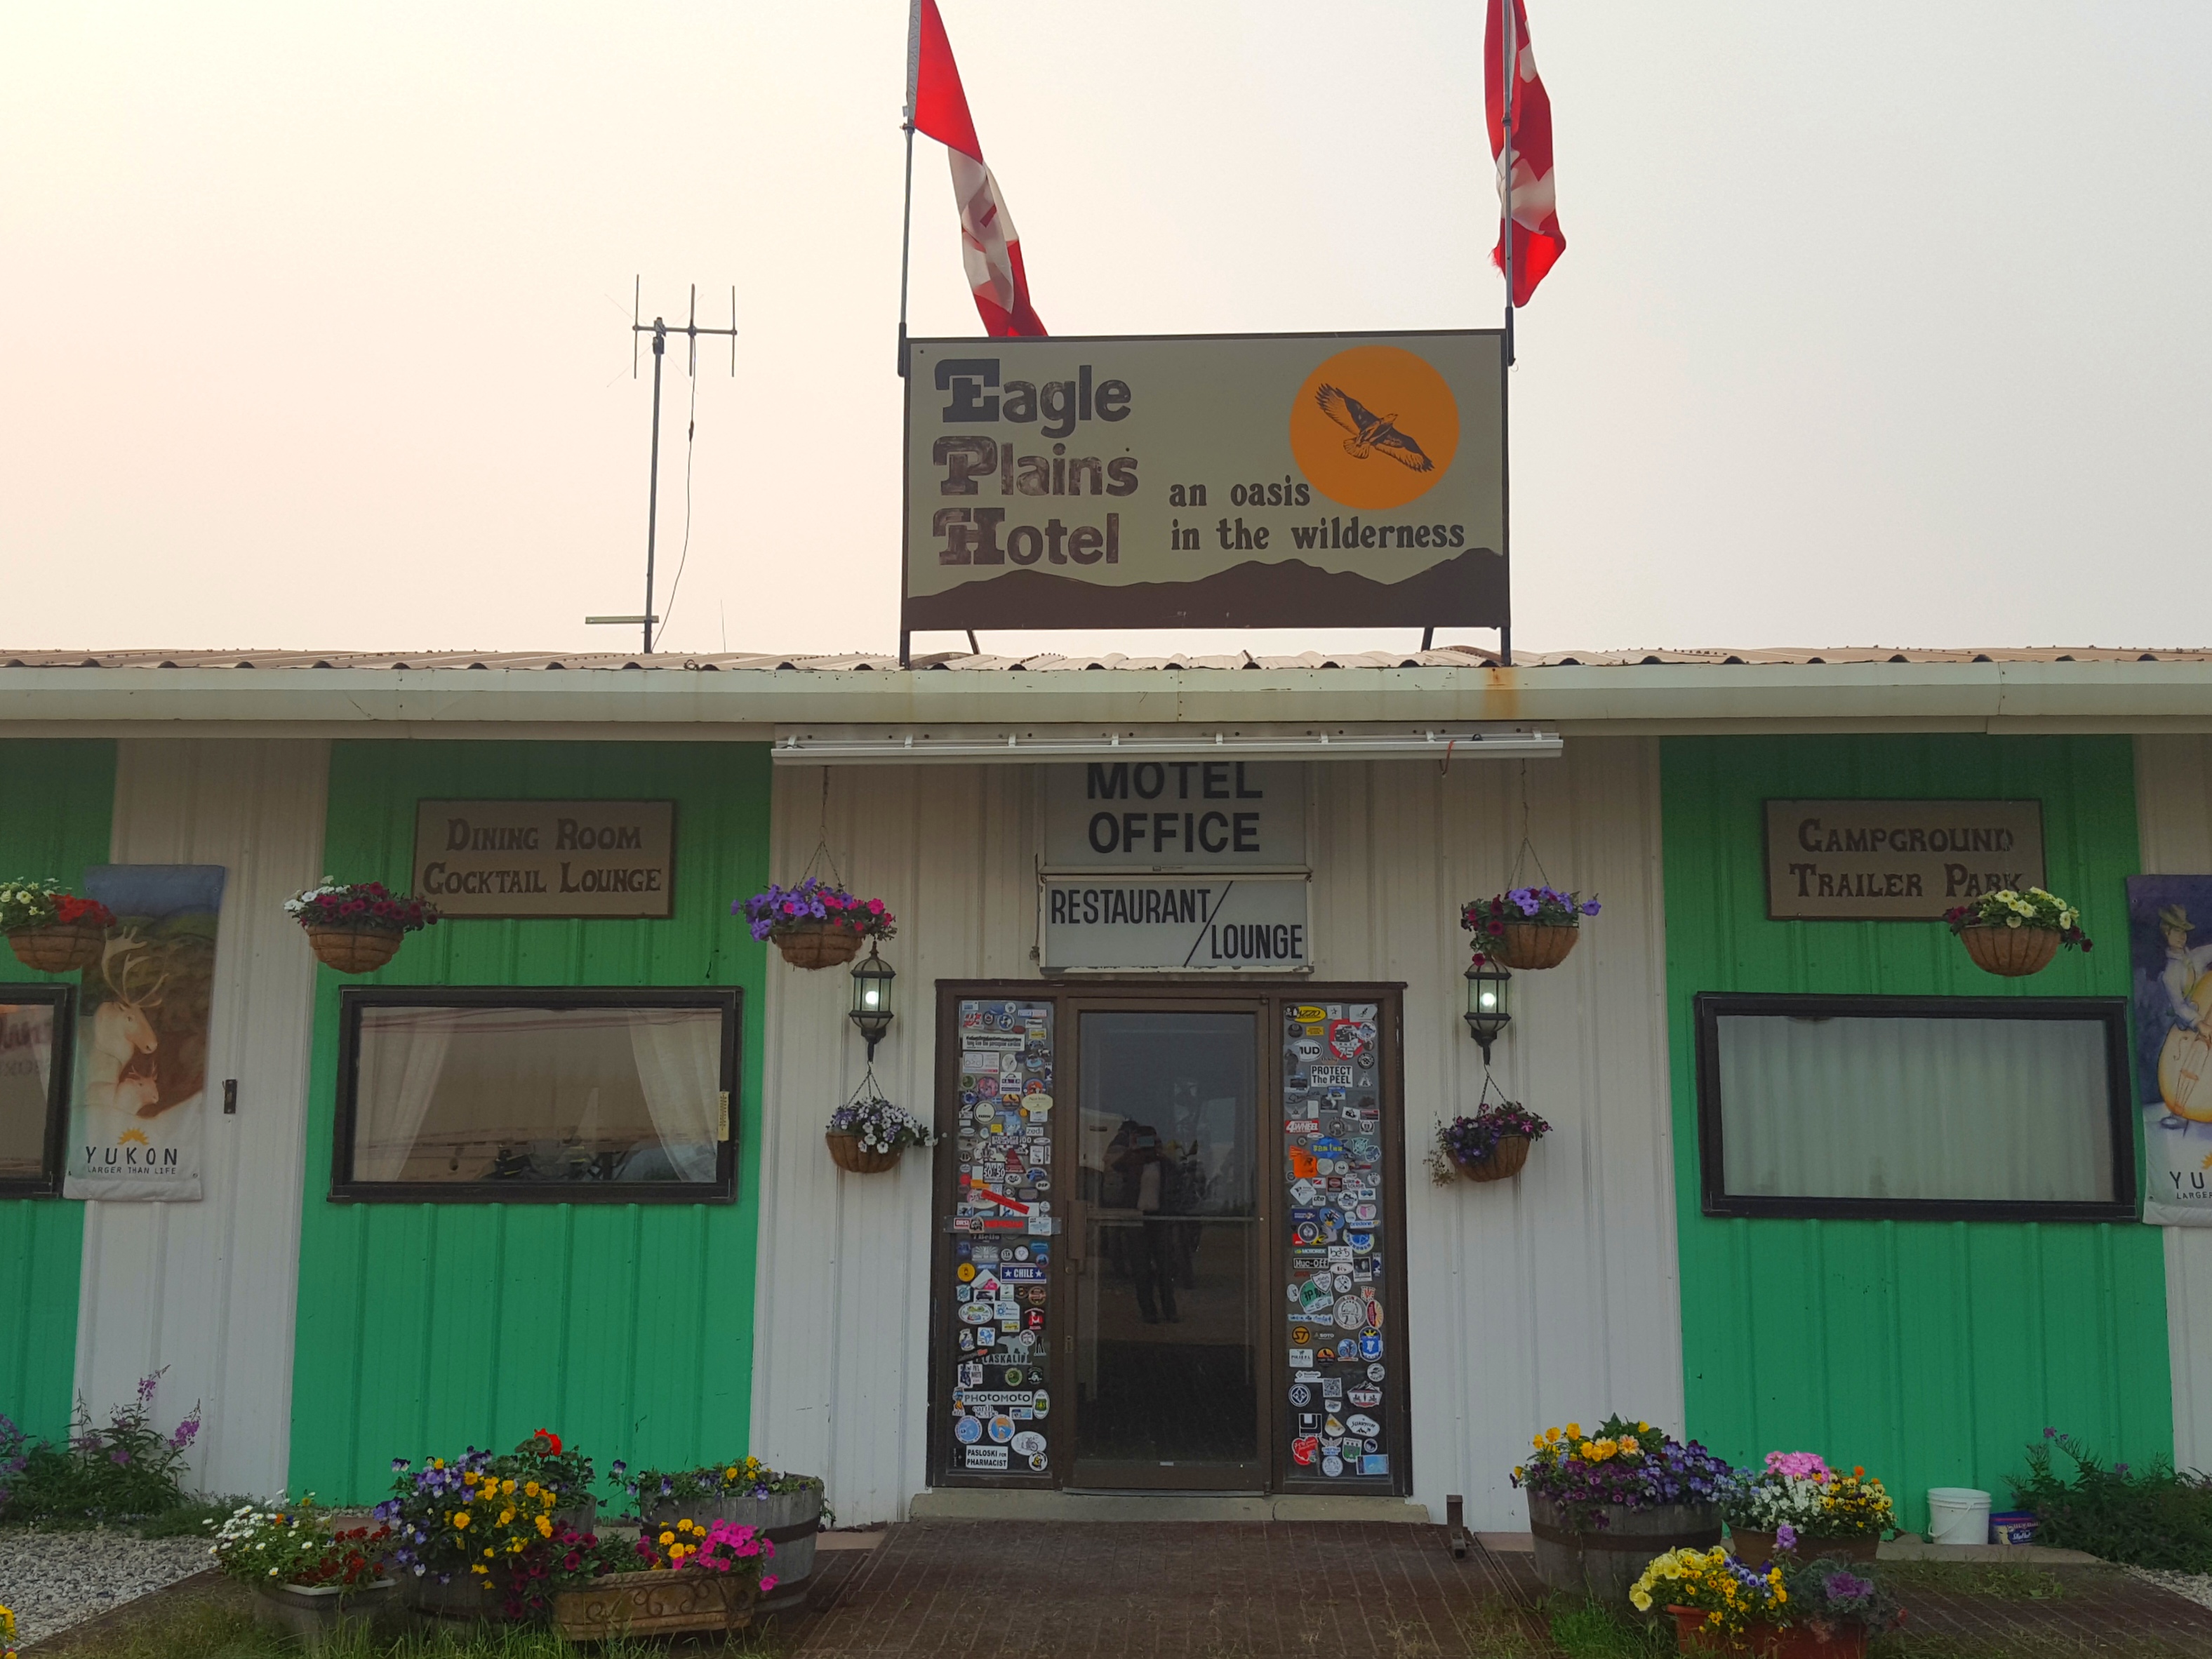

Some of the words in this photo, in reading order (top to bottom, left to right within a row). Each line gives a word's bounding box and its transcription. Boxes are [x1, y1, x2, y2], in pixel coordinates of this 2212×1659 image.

[933, 359, 1132, 438] Eagle
[932, 436, 1139, 497] Plains
[1168, 481, 1207, 507] an
[1230, 474, 1311, 507] oasis
[932, 507, 1120, 566] Hotel
[1171, 519, 1201, 551] in
[1216, 517, 1269, 551] the
[1292, 516, 1465, 550] wilderness
[1087, 761, 1263, 799] MOTEL
[1088, 811, 1260, 854] OFFICE
[1051, 888, 1211, 924] RESTAURANT
[1211, 924, 1302, 959] LOUNGE
[1312, 1066, 1351, 1075] PROTECT
[1312, 1075, 1328, 1084] The
[1330, 1076, 1352, 1084] PEEL
[86, 1146, 178, 1166] YUKON
[88, 1166, 122, 1174] LARGER
[128, 1166, 149, 1175] THAN
[1013, 1268, 1034, 1278] CHILE
[1295, 1259, 1328, 1267] Muc-Off
[966, 1458, 1007, 1467] PHARMACIST
[967, 1449, 998, 1458] PASLOSKI
